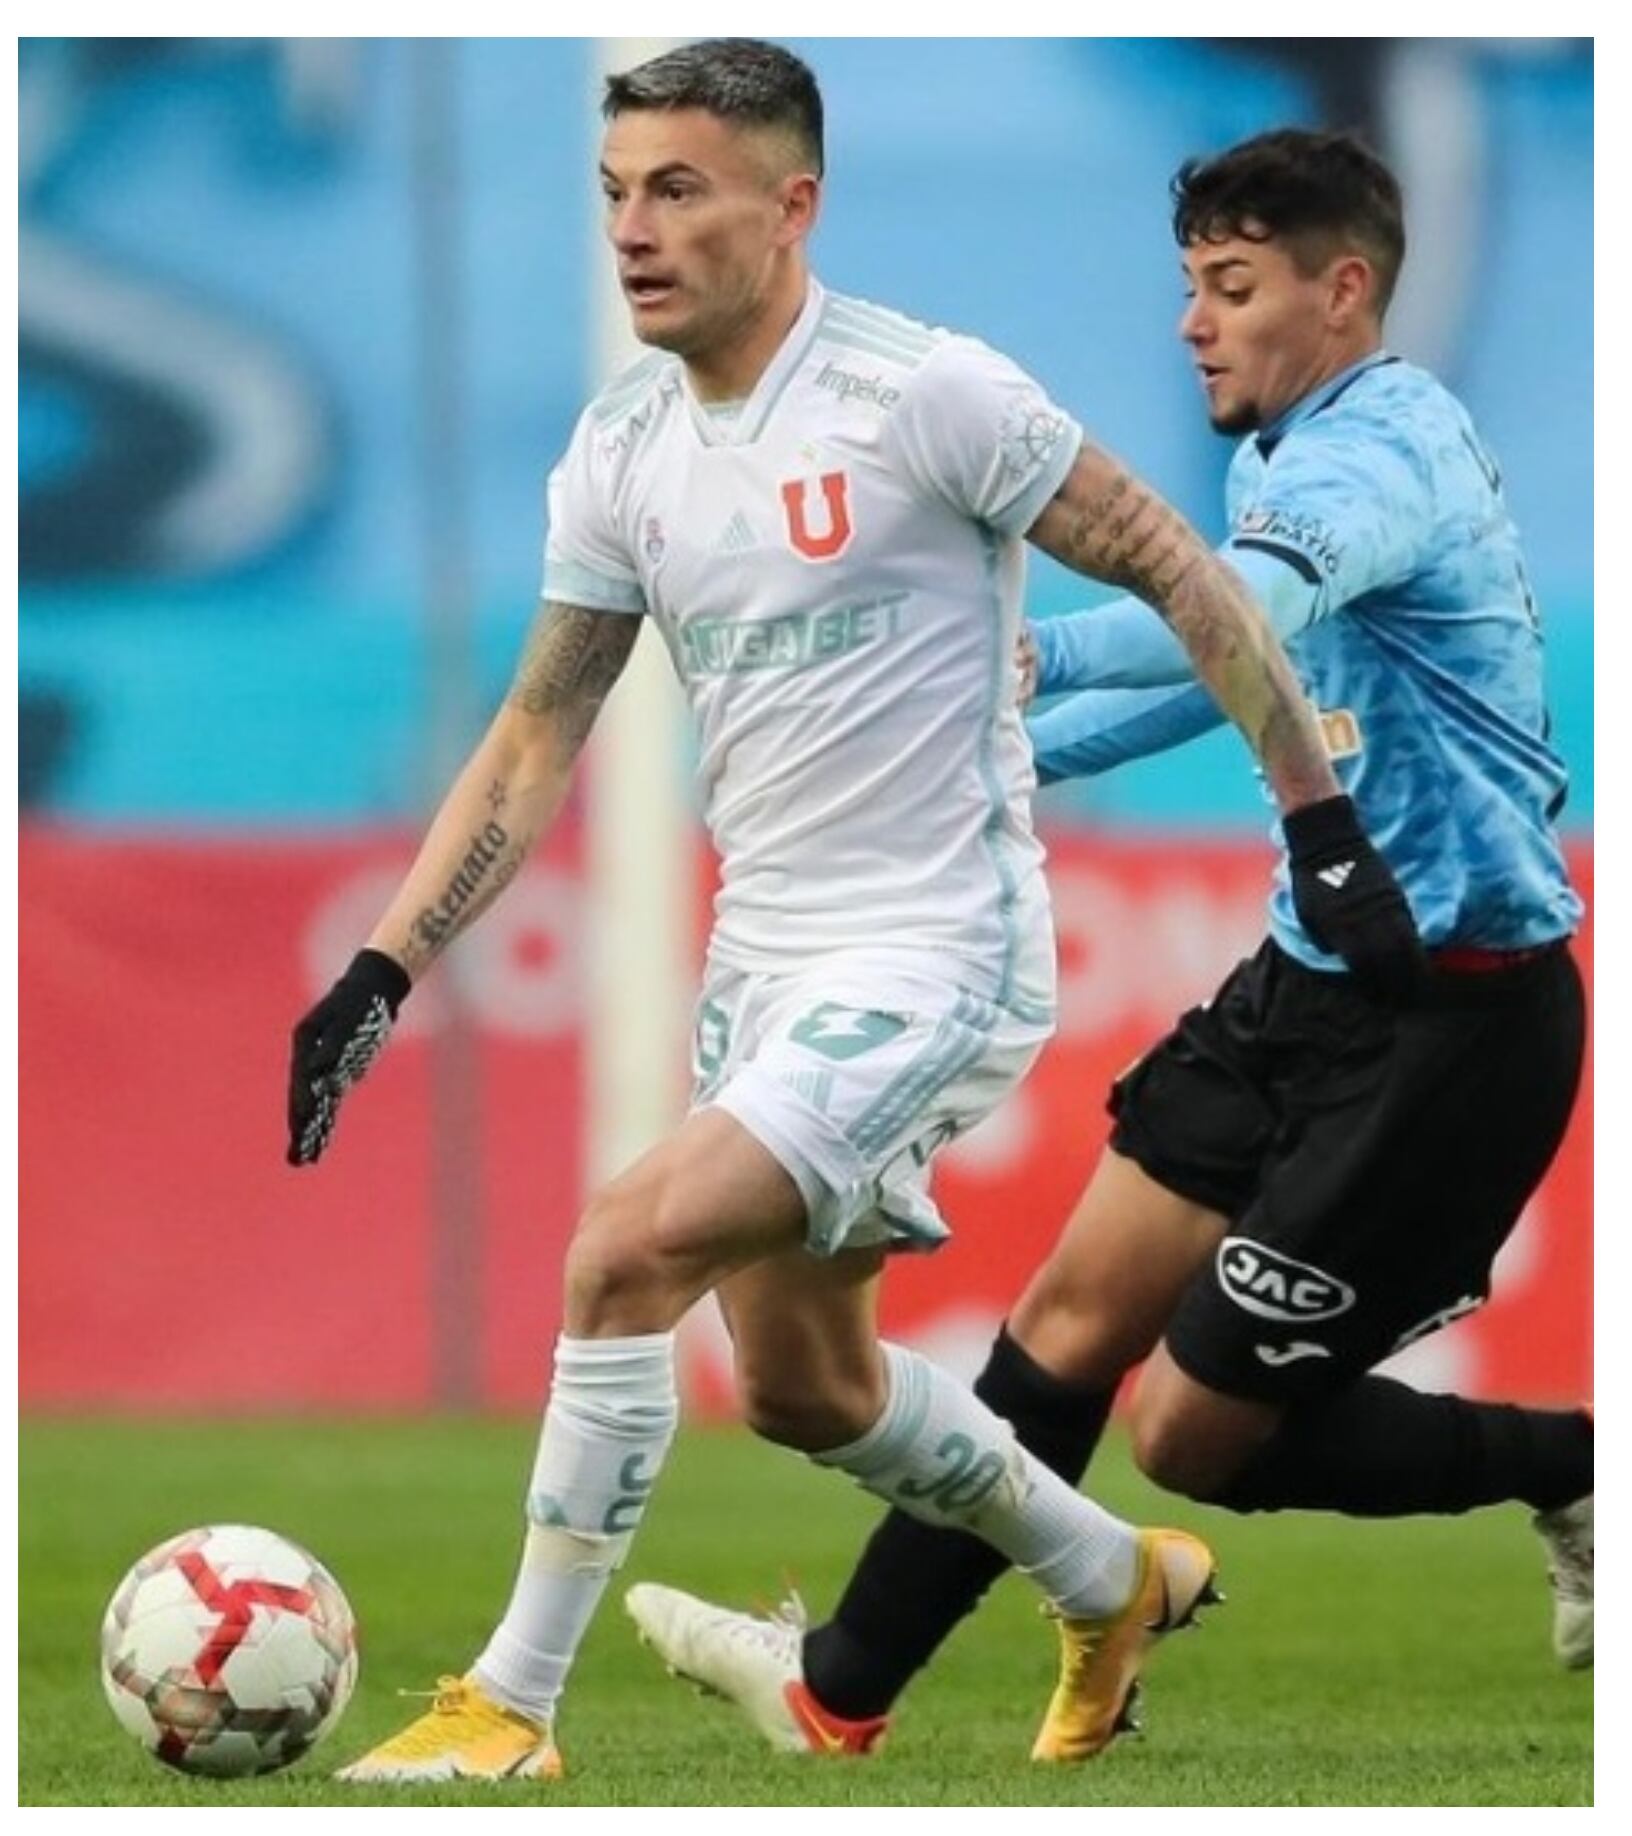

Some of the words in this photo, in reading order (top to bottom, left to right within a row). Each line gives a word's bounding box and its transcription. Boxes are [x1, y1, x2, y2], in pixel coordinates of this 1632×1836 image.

[811, 360, 901, 409] Impeke
[781, 471, 854, 558] U
[1221, 1248, 1330, 1310] JAC
